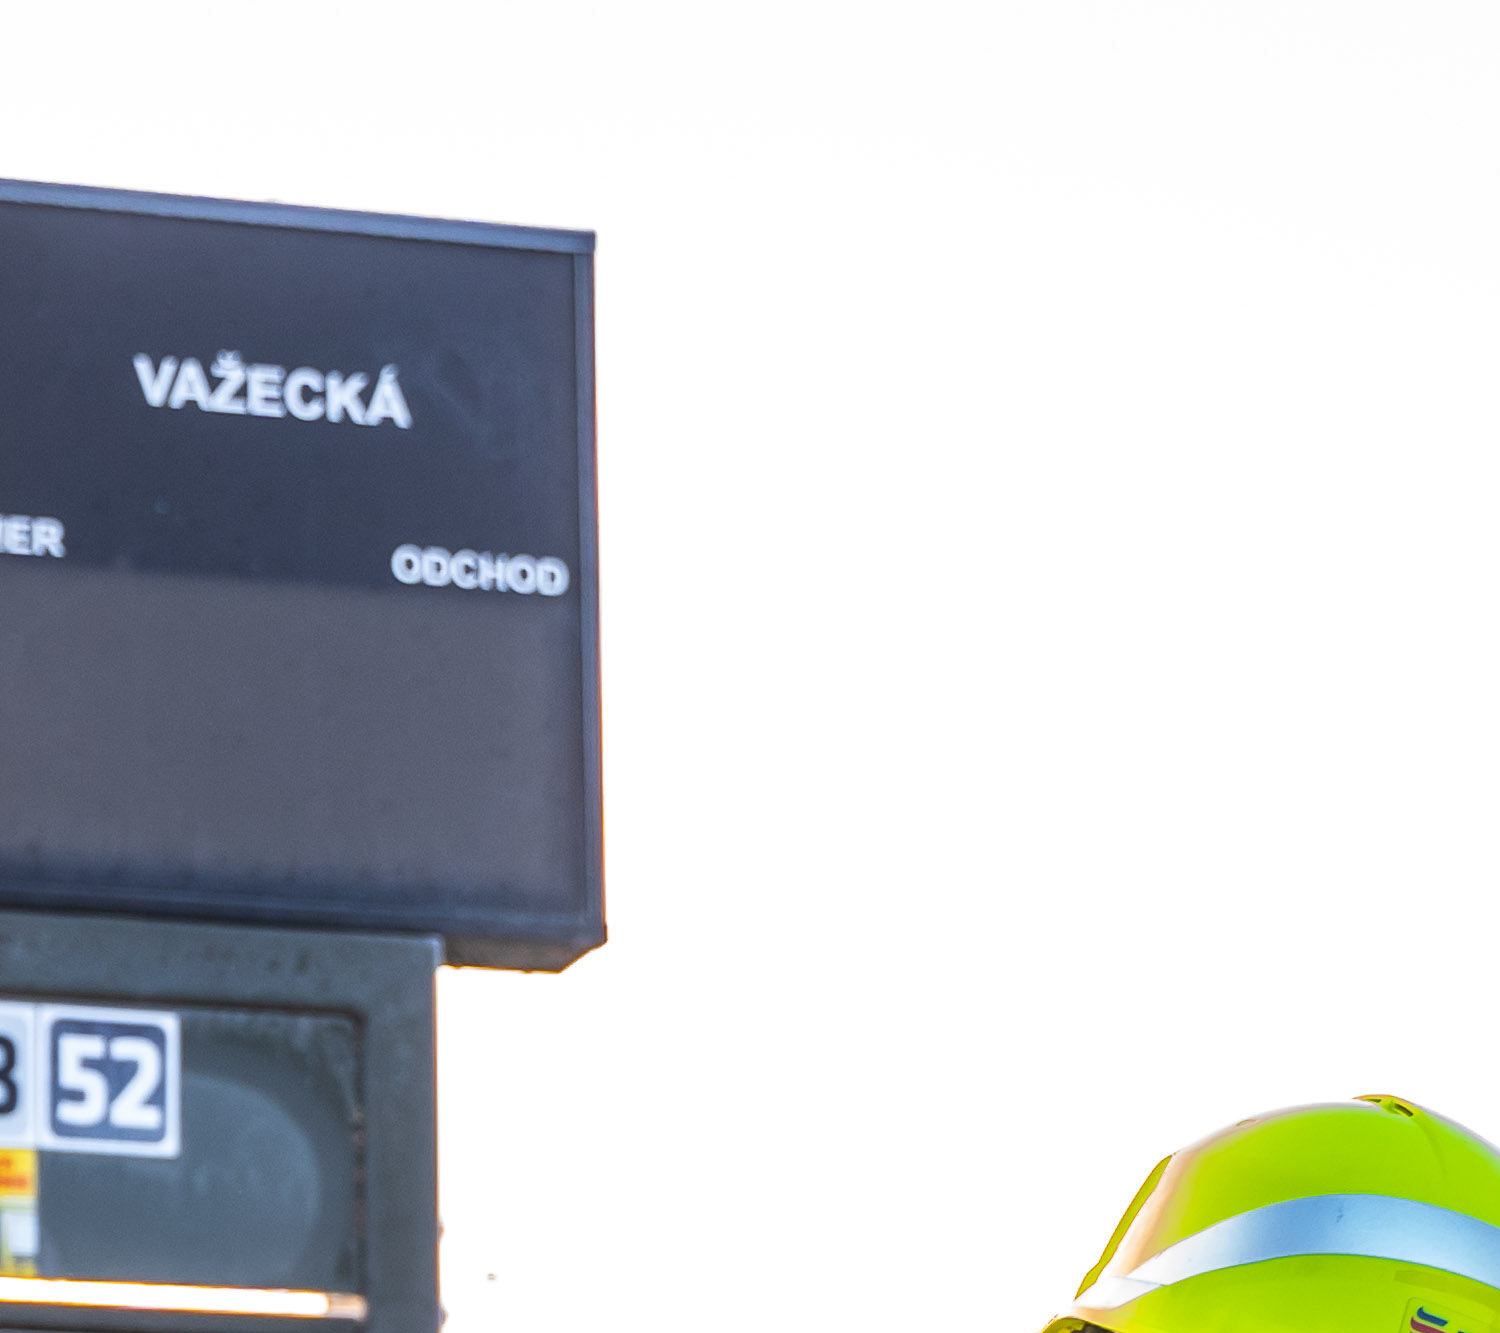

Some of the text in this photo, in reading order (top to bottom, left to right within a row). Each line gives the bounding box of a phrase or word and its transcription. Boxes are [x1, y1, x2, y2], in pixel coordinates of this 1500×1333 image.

[132, 350, 411, 428] VAŽECKÁ
[391, 544, 569, 597] ODCHOD
[56, 1034, 162, 1128] 52
